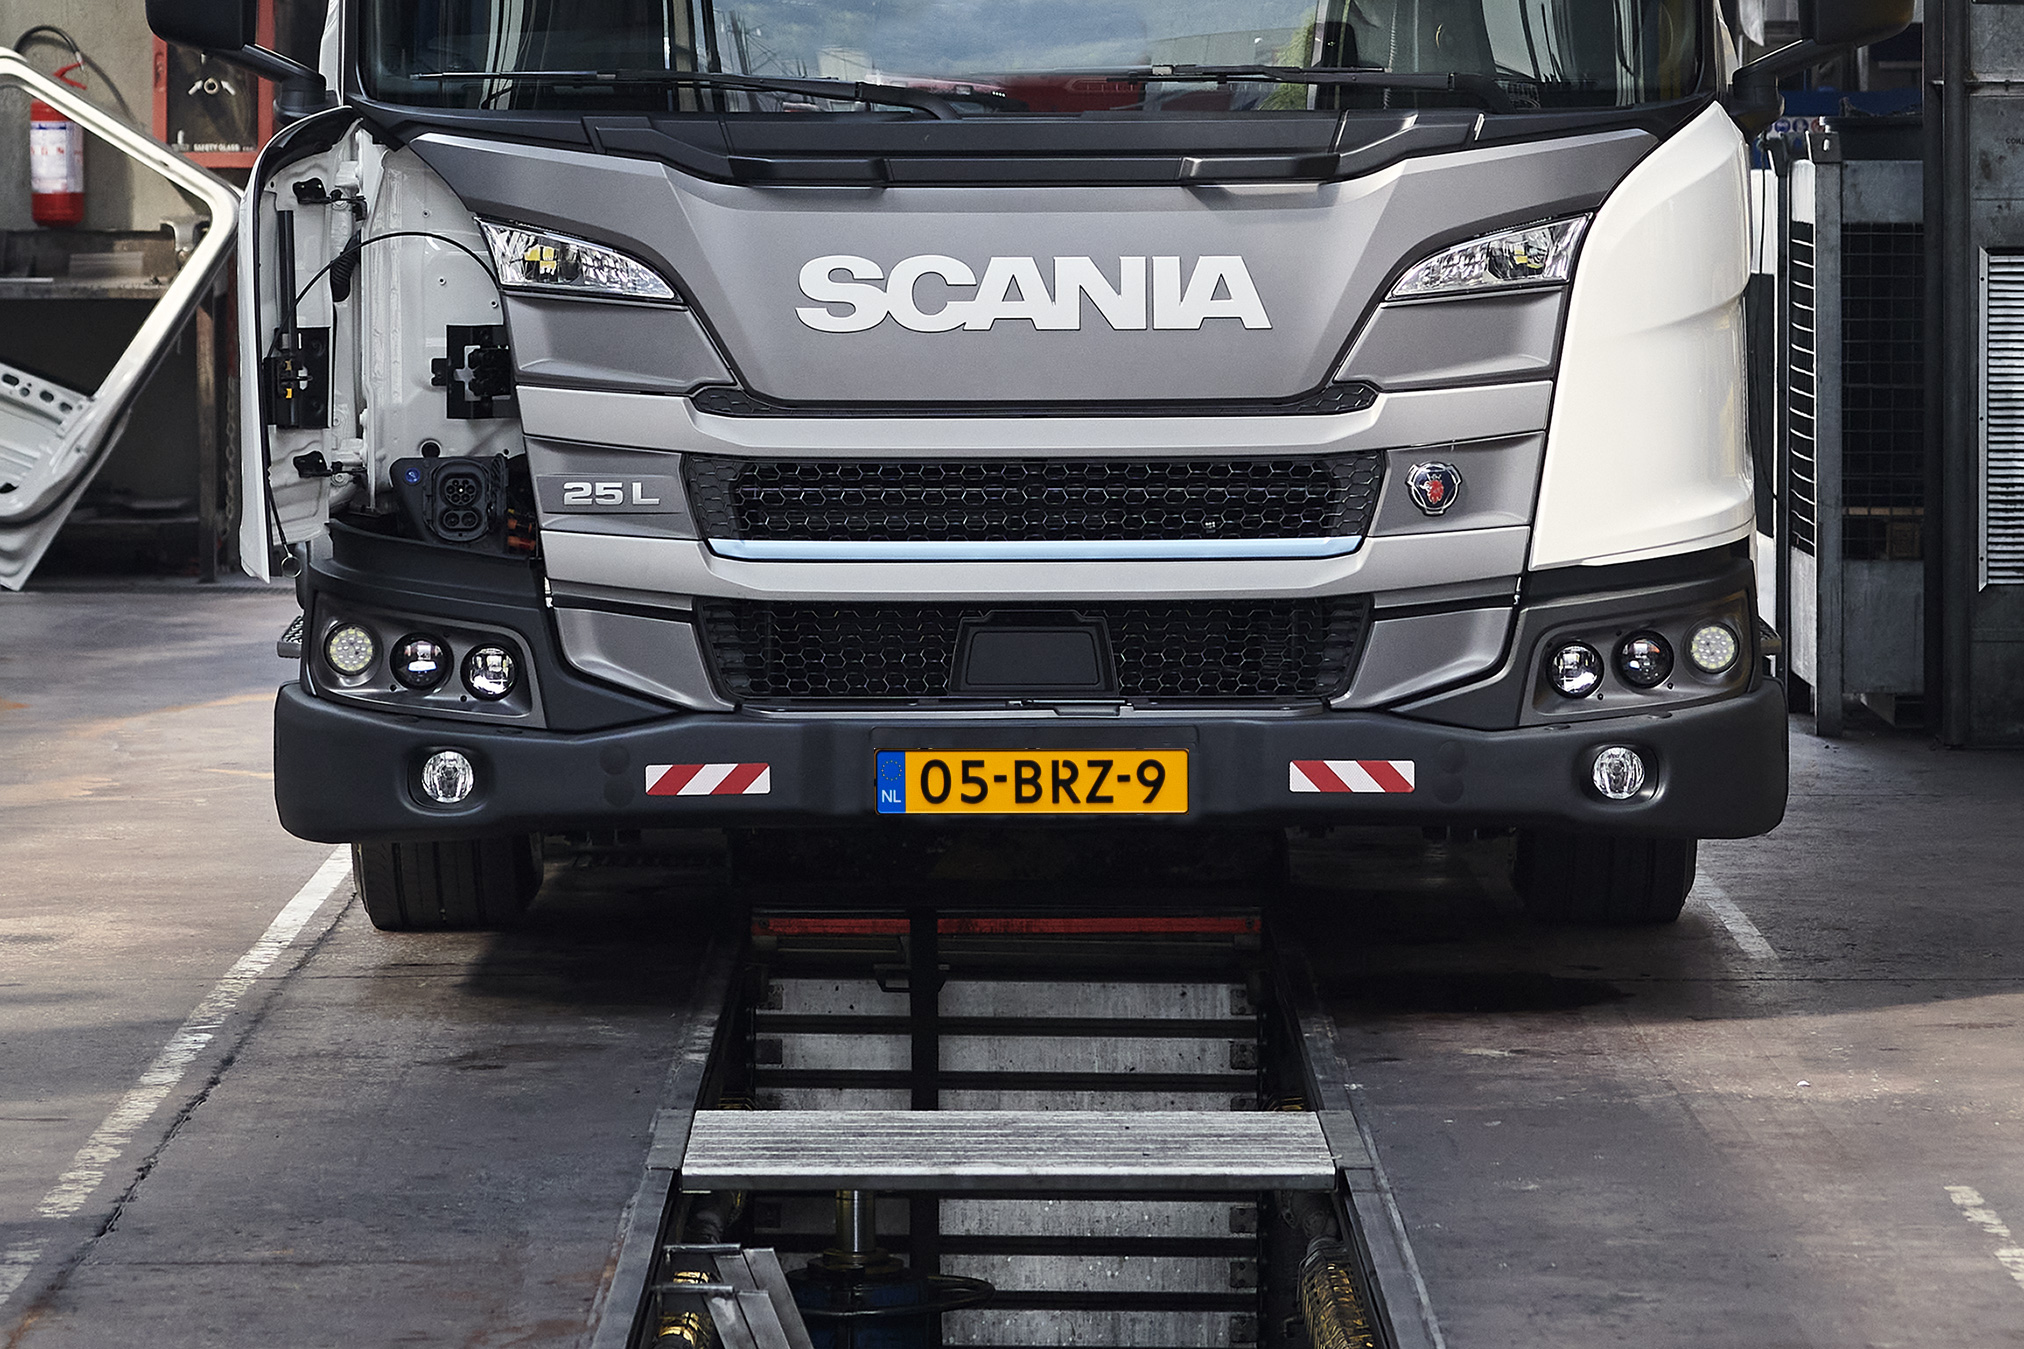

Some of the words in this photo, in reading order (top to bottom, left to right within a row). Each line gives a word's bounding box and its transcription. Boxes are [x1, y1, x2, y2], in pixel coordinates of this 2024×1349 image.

[193, 143, 218, 152] SAFETY
[218, 143, 240, 152] GLASS
[795, 254, 1273, 334] SCANIA
[880, 789, 902, 803] NL
[919, 758, 1167, 805] 05-BRZ-9
